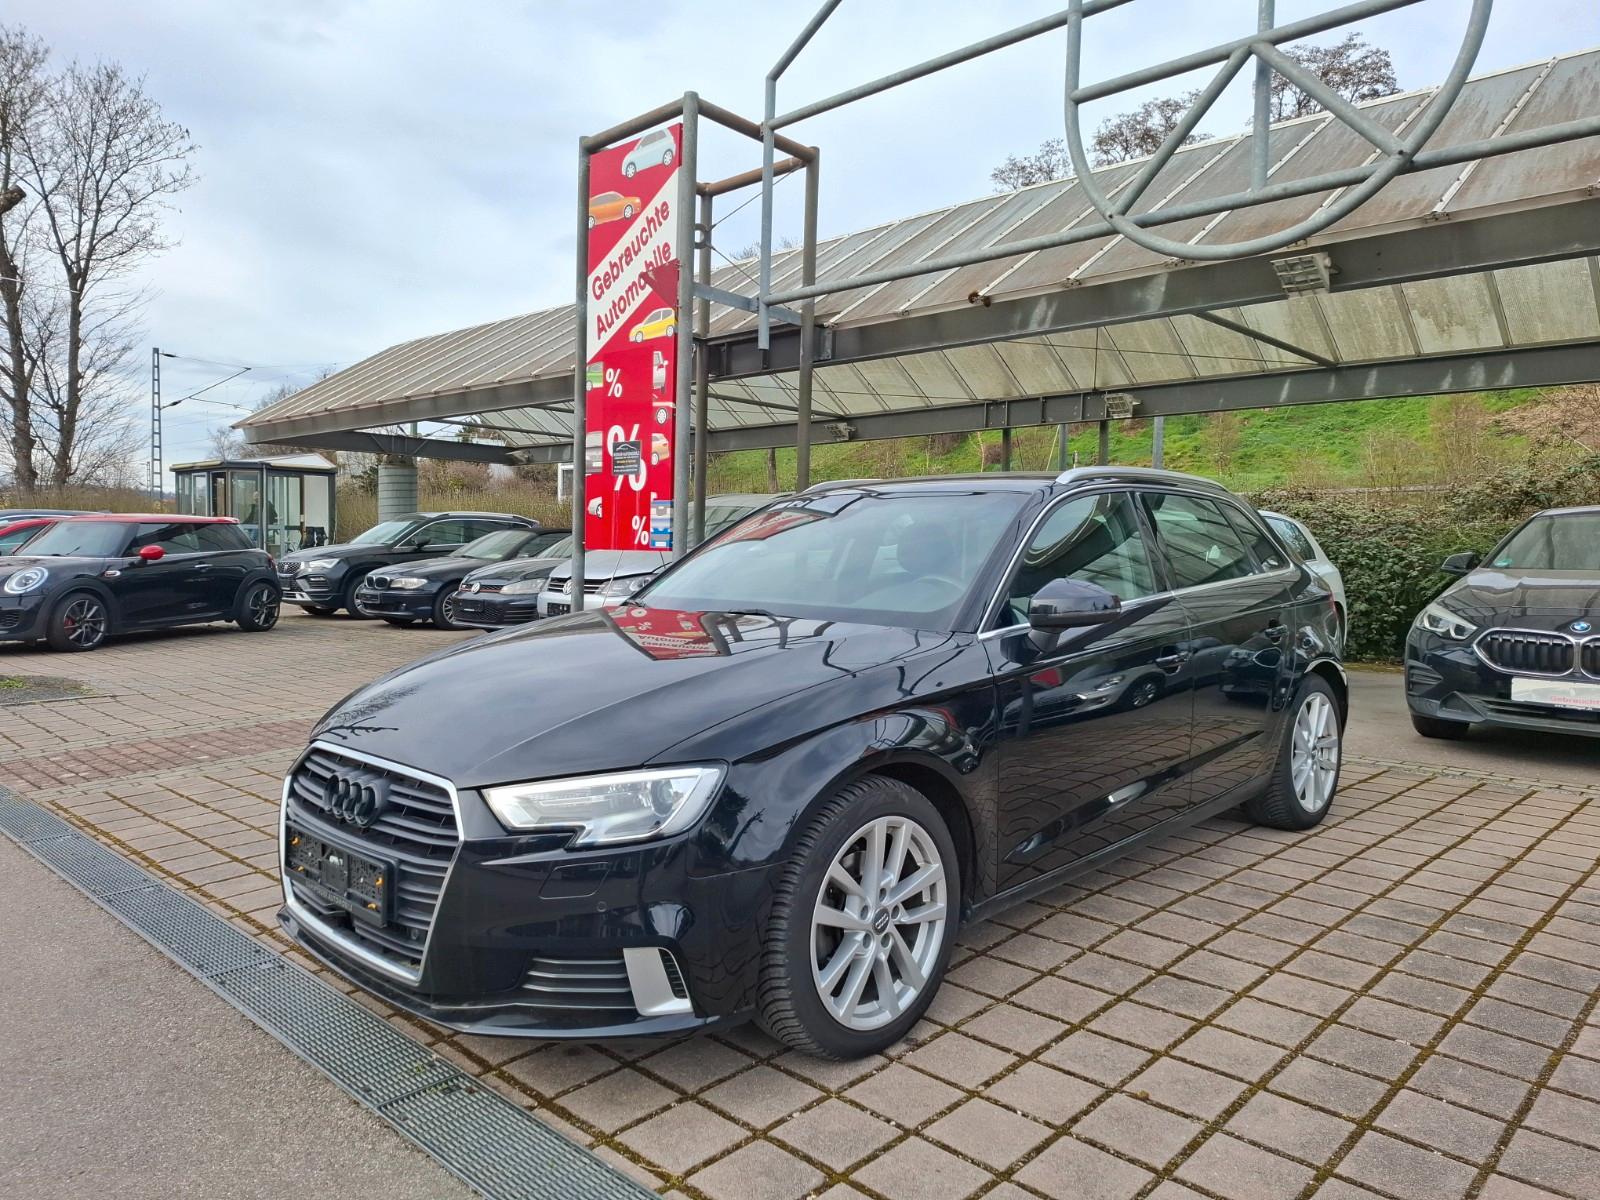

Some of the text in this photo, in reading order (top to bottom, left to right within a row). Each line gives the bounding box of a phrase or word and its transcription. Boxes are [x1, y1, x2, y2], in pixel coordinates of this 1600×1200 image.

[592, 200, 670, 301] Gebrauchte
[605, 368, 623, 398] %
[631, 515, 649, 545] %
